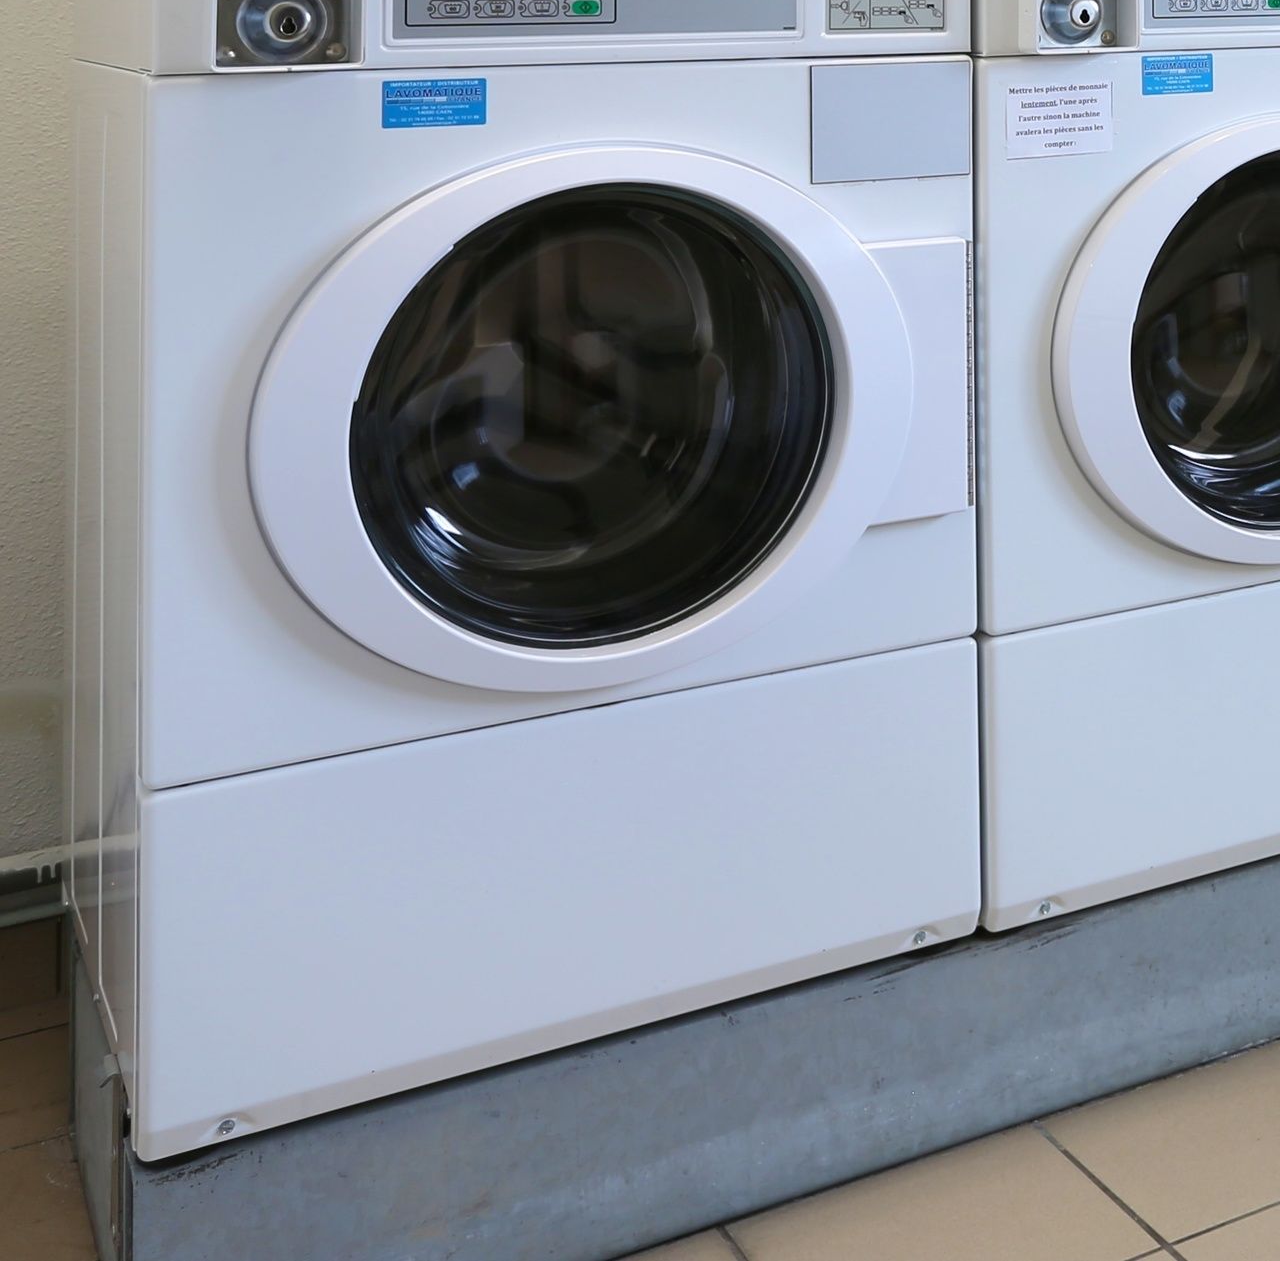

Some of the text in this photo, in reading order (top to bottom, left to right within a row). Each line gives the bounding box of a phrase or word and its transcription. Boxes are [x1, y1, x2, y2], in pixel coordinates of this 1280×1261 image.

[1144, 61, 1209, 71] LAVOMATIQUE
[386, 87, 481, 99] LAVOMATIQUE
[1008, 86, 1033, 95] Mettre
[1034, 86, 1044, 94] les
[1045, 85, 1067, 95] pièces
[1079, 82, 1108, 91] monnaie
[1018, 114, 1041, 122] l'autre
[1071, 111, 1100, 119] machine
